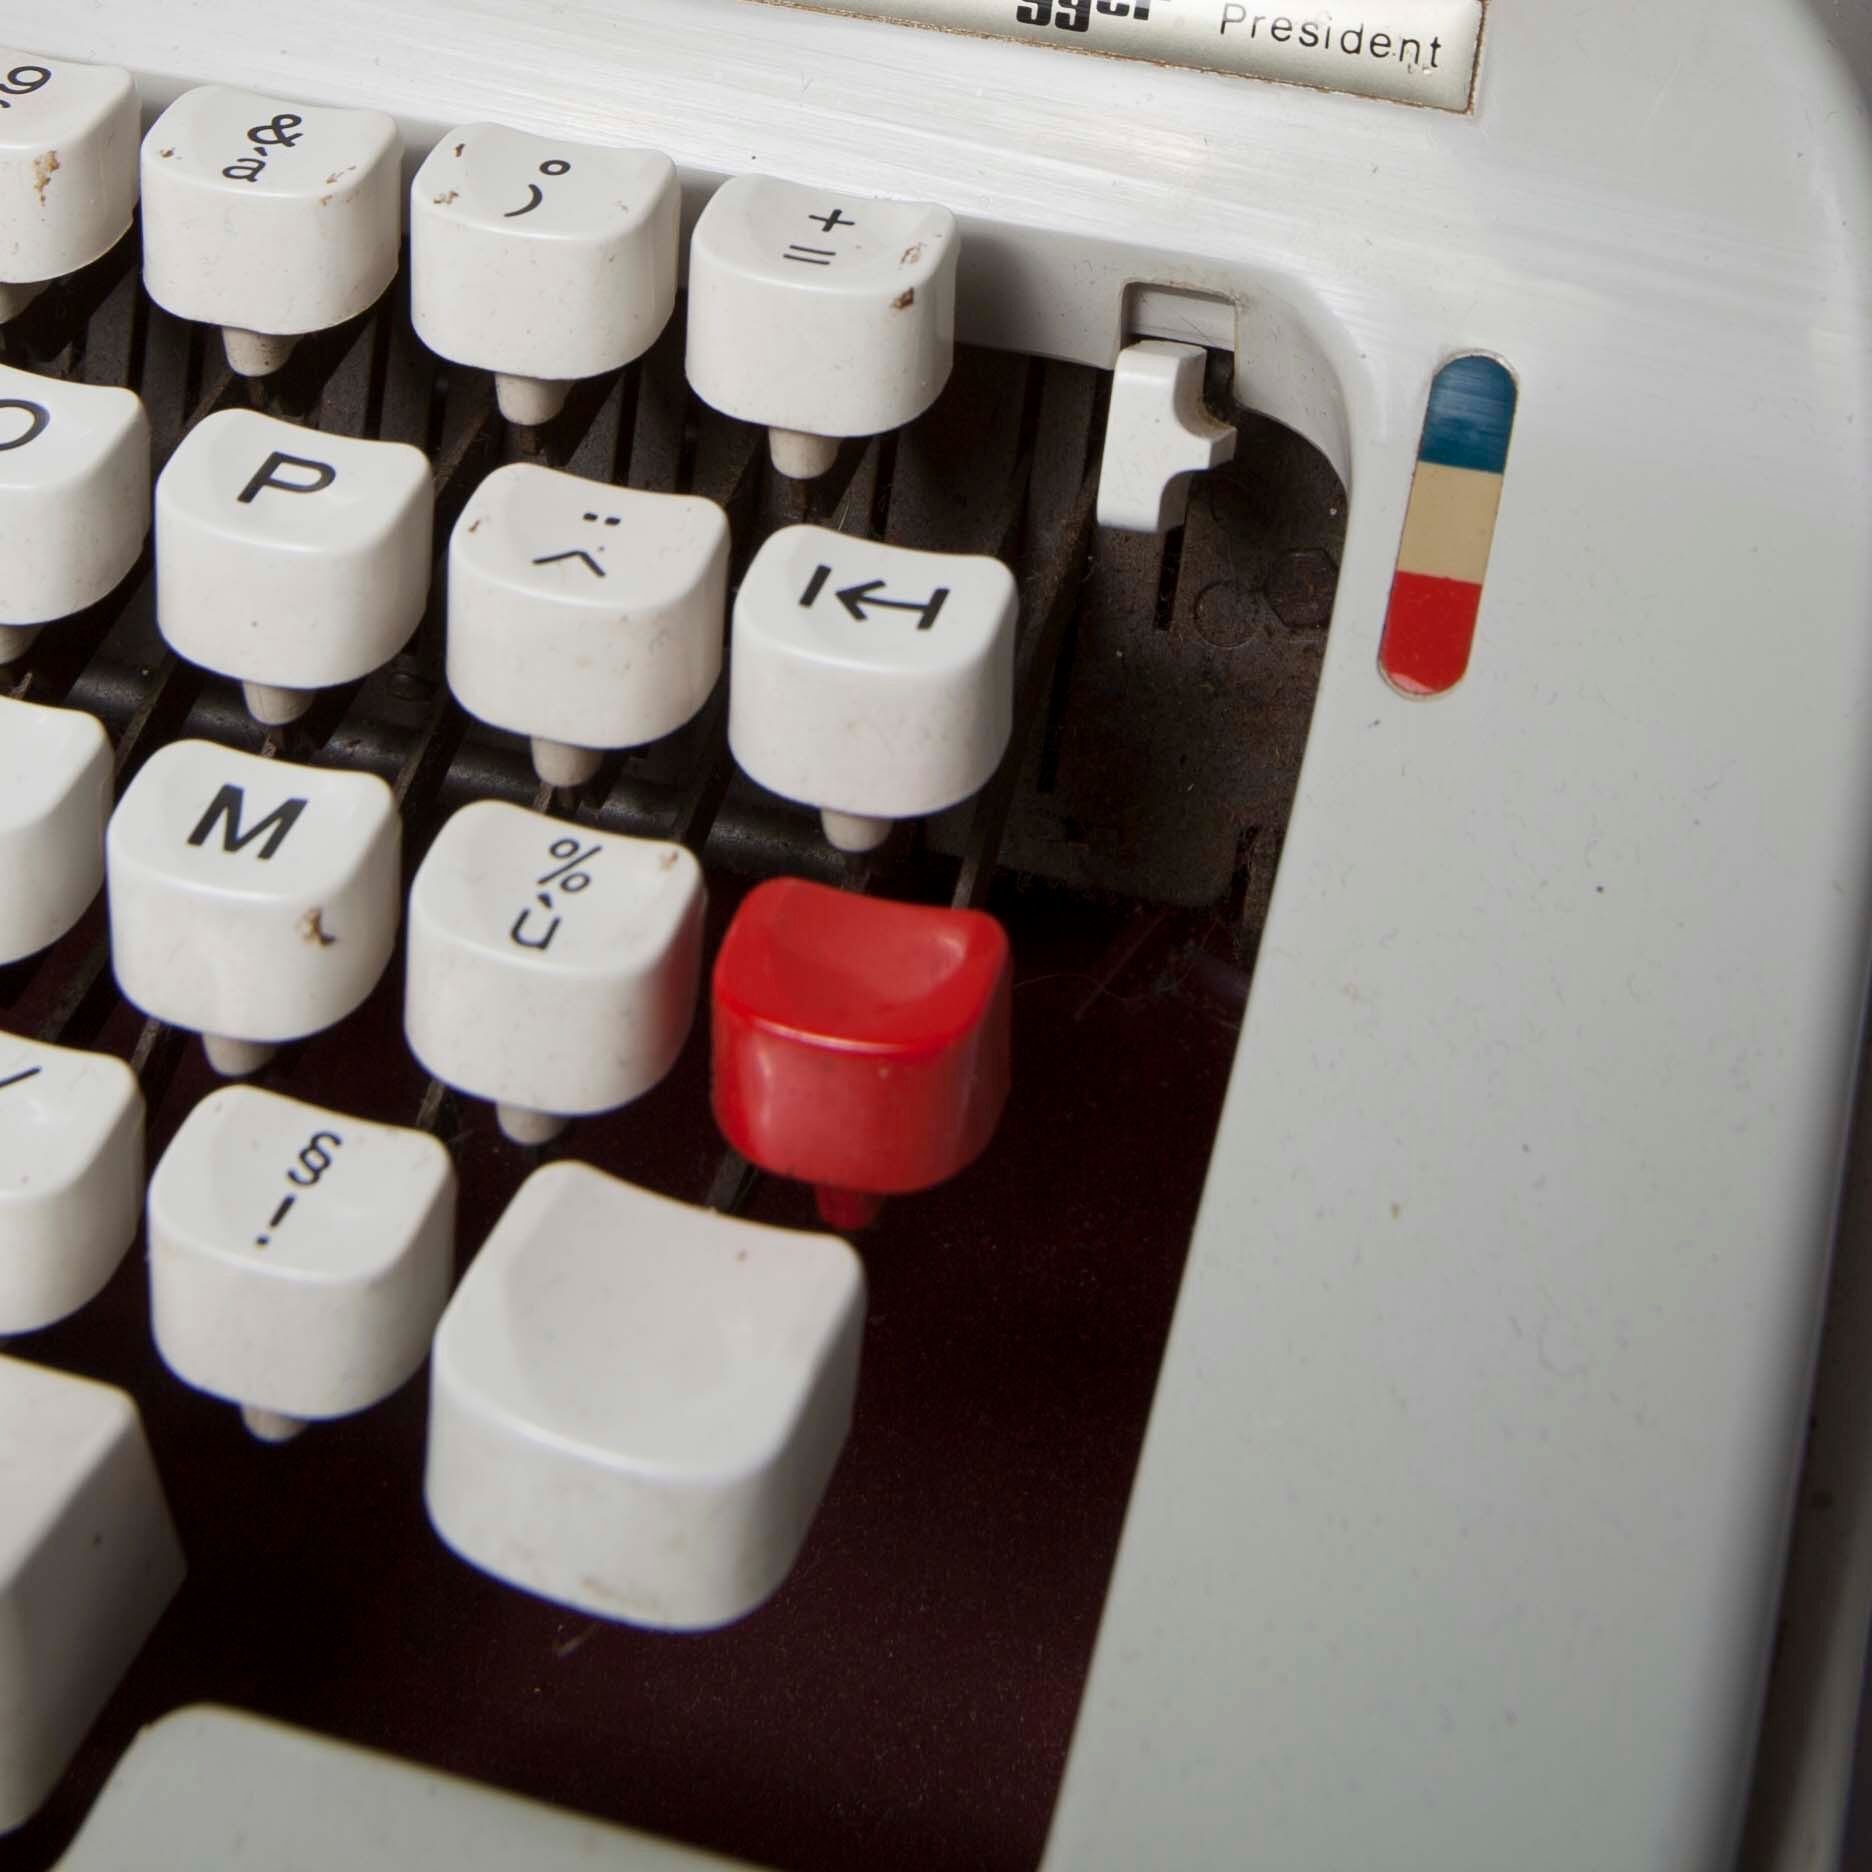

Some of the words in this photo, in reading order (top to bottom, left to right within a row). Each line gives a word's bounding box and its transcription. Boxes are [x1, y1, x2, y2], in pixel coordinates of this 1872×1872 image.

[1217, 0, 1443, 71] President
[246, 112, 304, 152] &
[807, 208, 856, 234] +
[236, 450, 337, 505] P
[186, 783, 309, 861] M
[542, 837, 601, 894] %
[509, 892, 562, 952] ù
[286, 1131, 343, 1187] §
[256, 1195, 296, 1247] !
